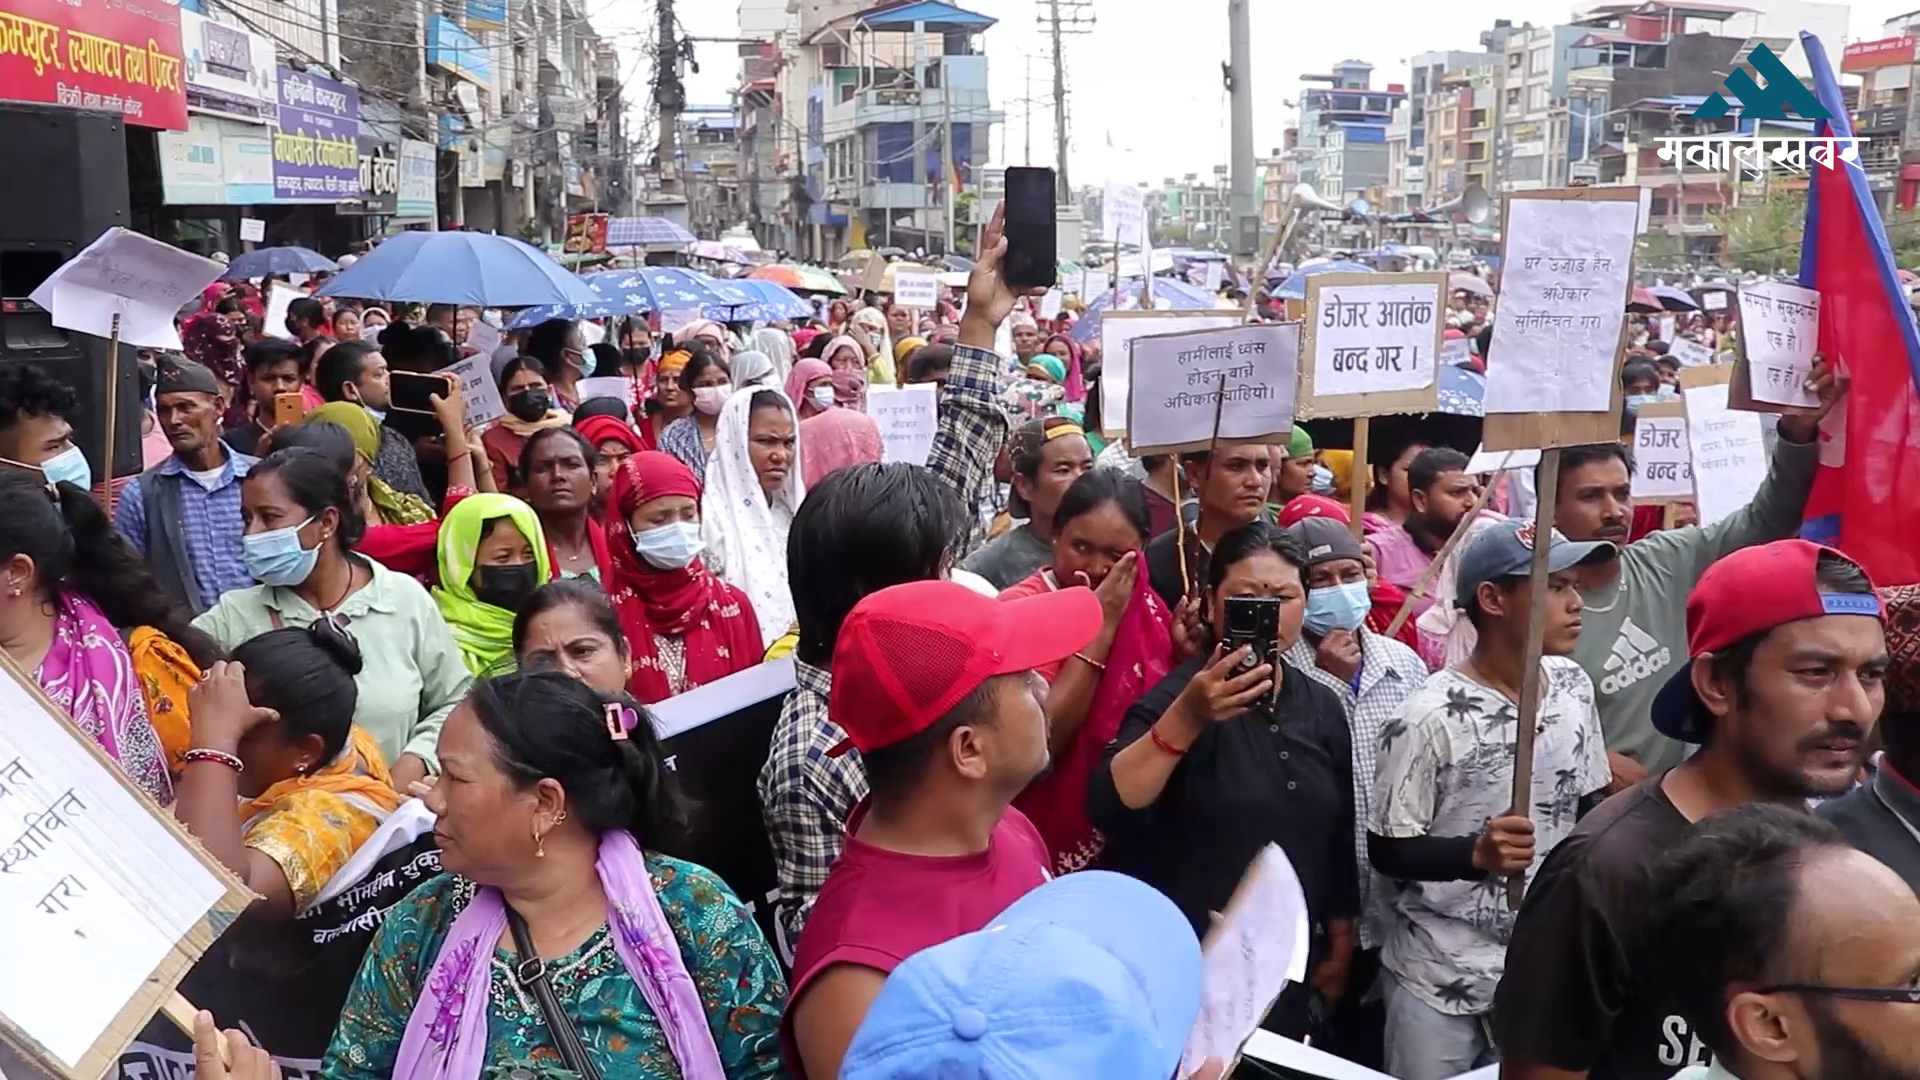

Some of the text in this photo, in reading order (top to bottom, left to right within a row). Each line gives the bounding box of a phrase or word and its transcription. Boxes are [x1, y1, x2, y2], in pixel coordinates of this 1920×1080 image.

[123, 43, 148, 85] तथा
[1524, 256, 1541, 270] घर
[1542, 283, 1591, 301] अधिकार
[1323, 294, 1433, 328] डोजर आतंक
[1177, 340, 1266, 365] हामीलाई ध्वंस
[1333, 347, 1370, 373] बन्द
[1375, 346, 1404, 372] गर
[1639, 422, 1682, 448] डोजर
[1646, 462, 1680, 482] बन्द
[1600, 647, 1671, 695] adidas
